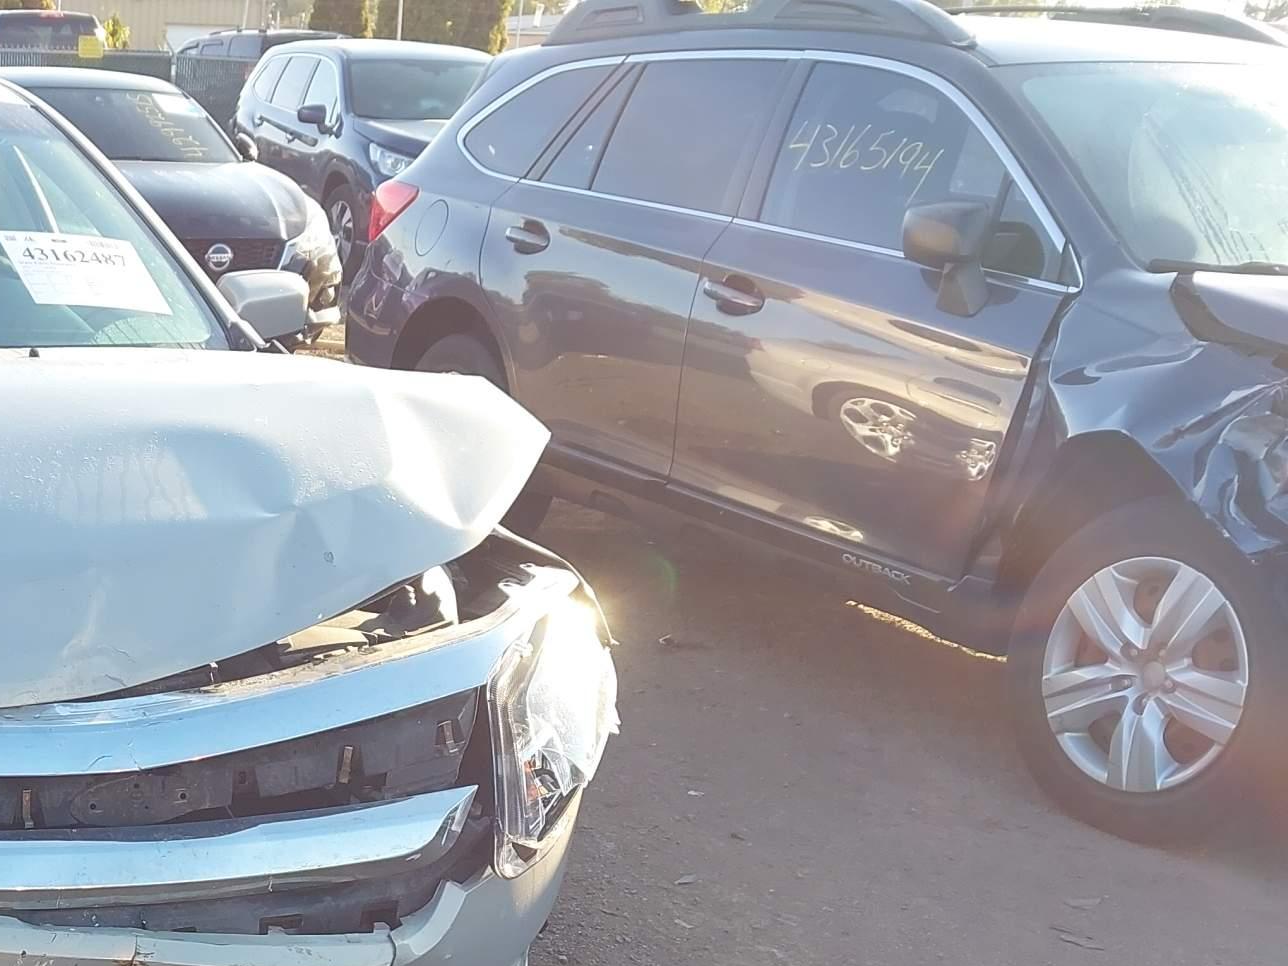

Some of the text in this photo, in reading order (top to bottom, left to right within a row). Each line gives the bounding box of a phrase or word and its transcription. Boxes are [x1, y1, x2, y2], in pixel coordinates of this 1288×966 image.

[788, 120, 945, 208] 43165194
[21, 246, 127, 267] 43162487
[842, 553, 911, 585] OUTBACK
